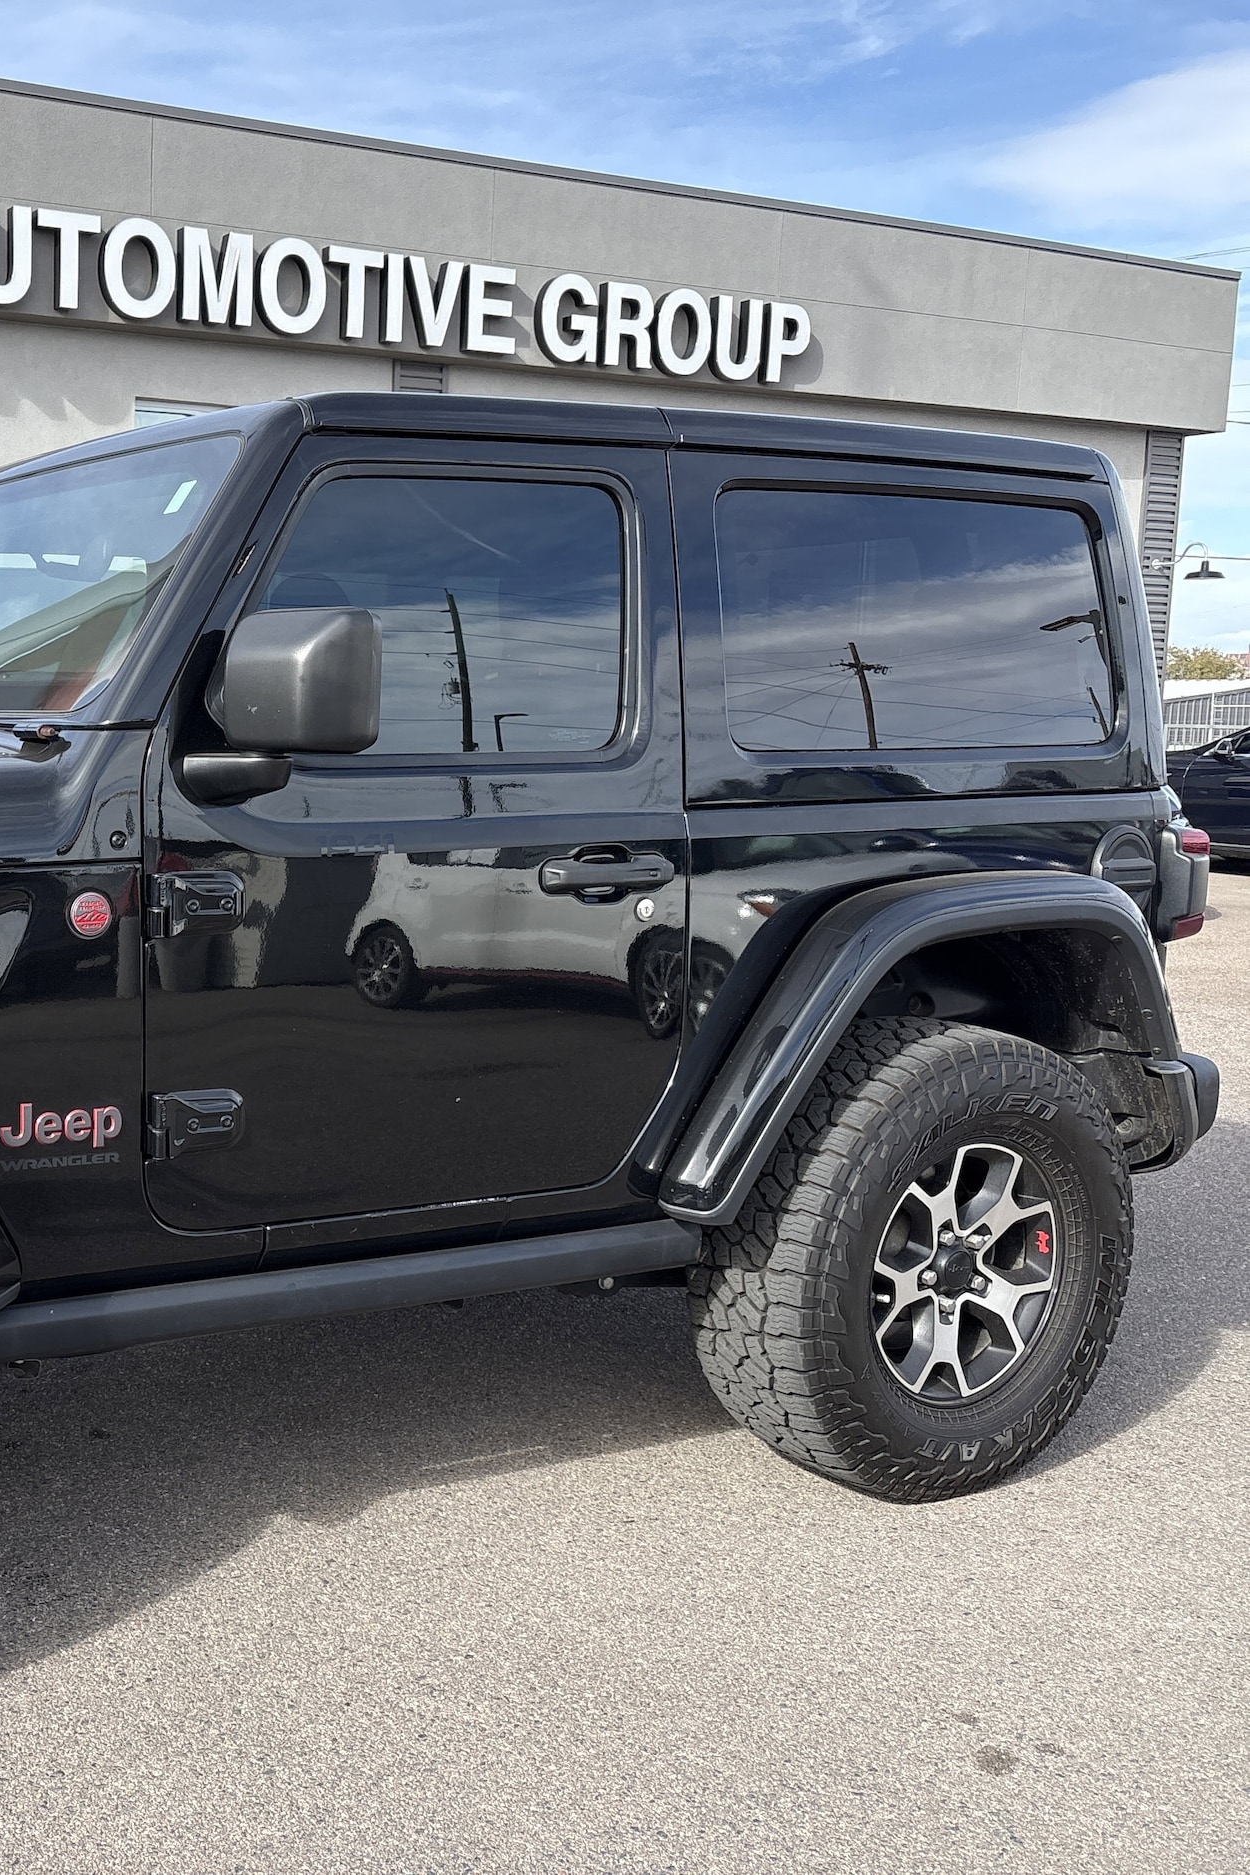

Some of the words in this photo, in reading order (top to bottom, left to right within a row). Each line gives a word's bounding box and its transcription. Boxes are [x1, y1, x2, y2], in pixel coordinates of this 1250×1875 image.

[535, 273, 811, 384] GROUP
[0, 1102, 123, 1149] Jeep
[0, 1152, 121, 1172] WRANGLER
